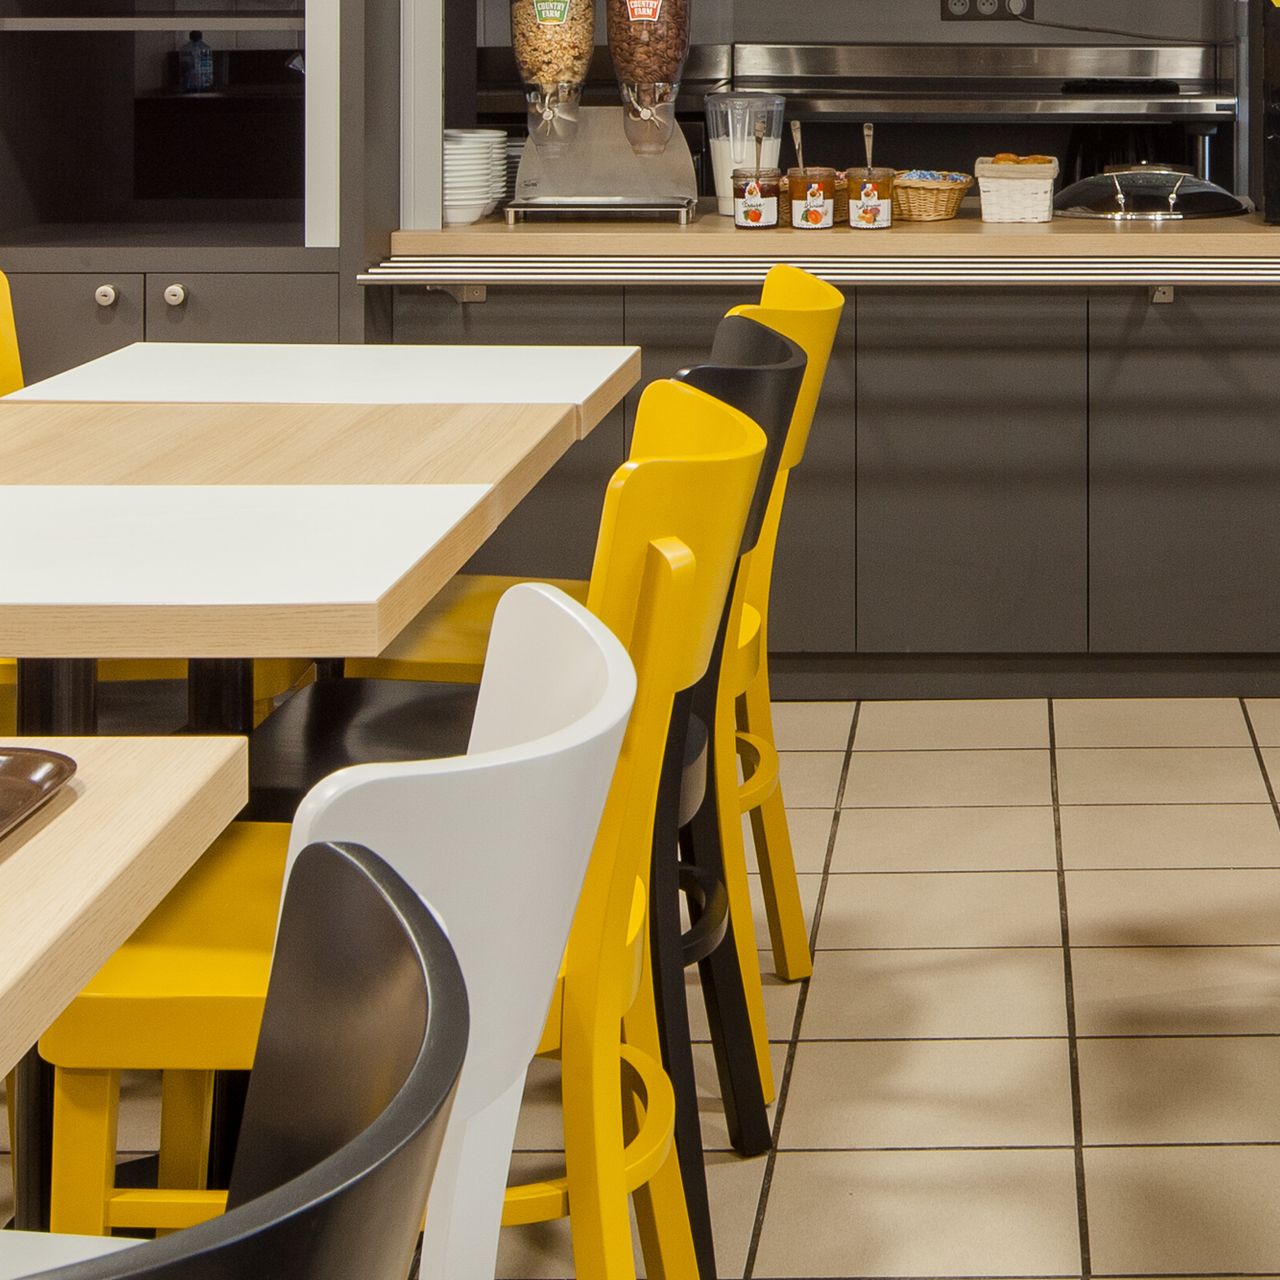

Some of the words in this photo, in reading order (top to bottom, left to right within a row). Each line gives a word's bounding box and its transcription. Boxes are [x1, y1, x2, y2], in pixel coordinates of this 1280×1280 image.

[538, 2, 566, 11] COUNTRY
[630, 0, 658, 8] COUNTRY
[542, 10, 561, 18] FARM
[634, 7, 653, 16] FARM
